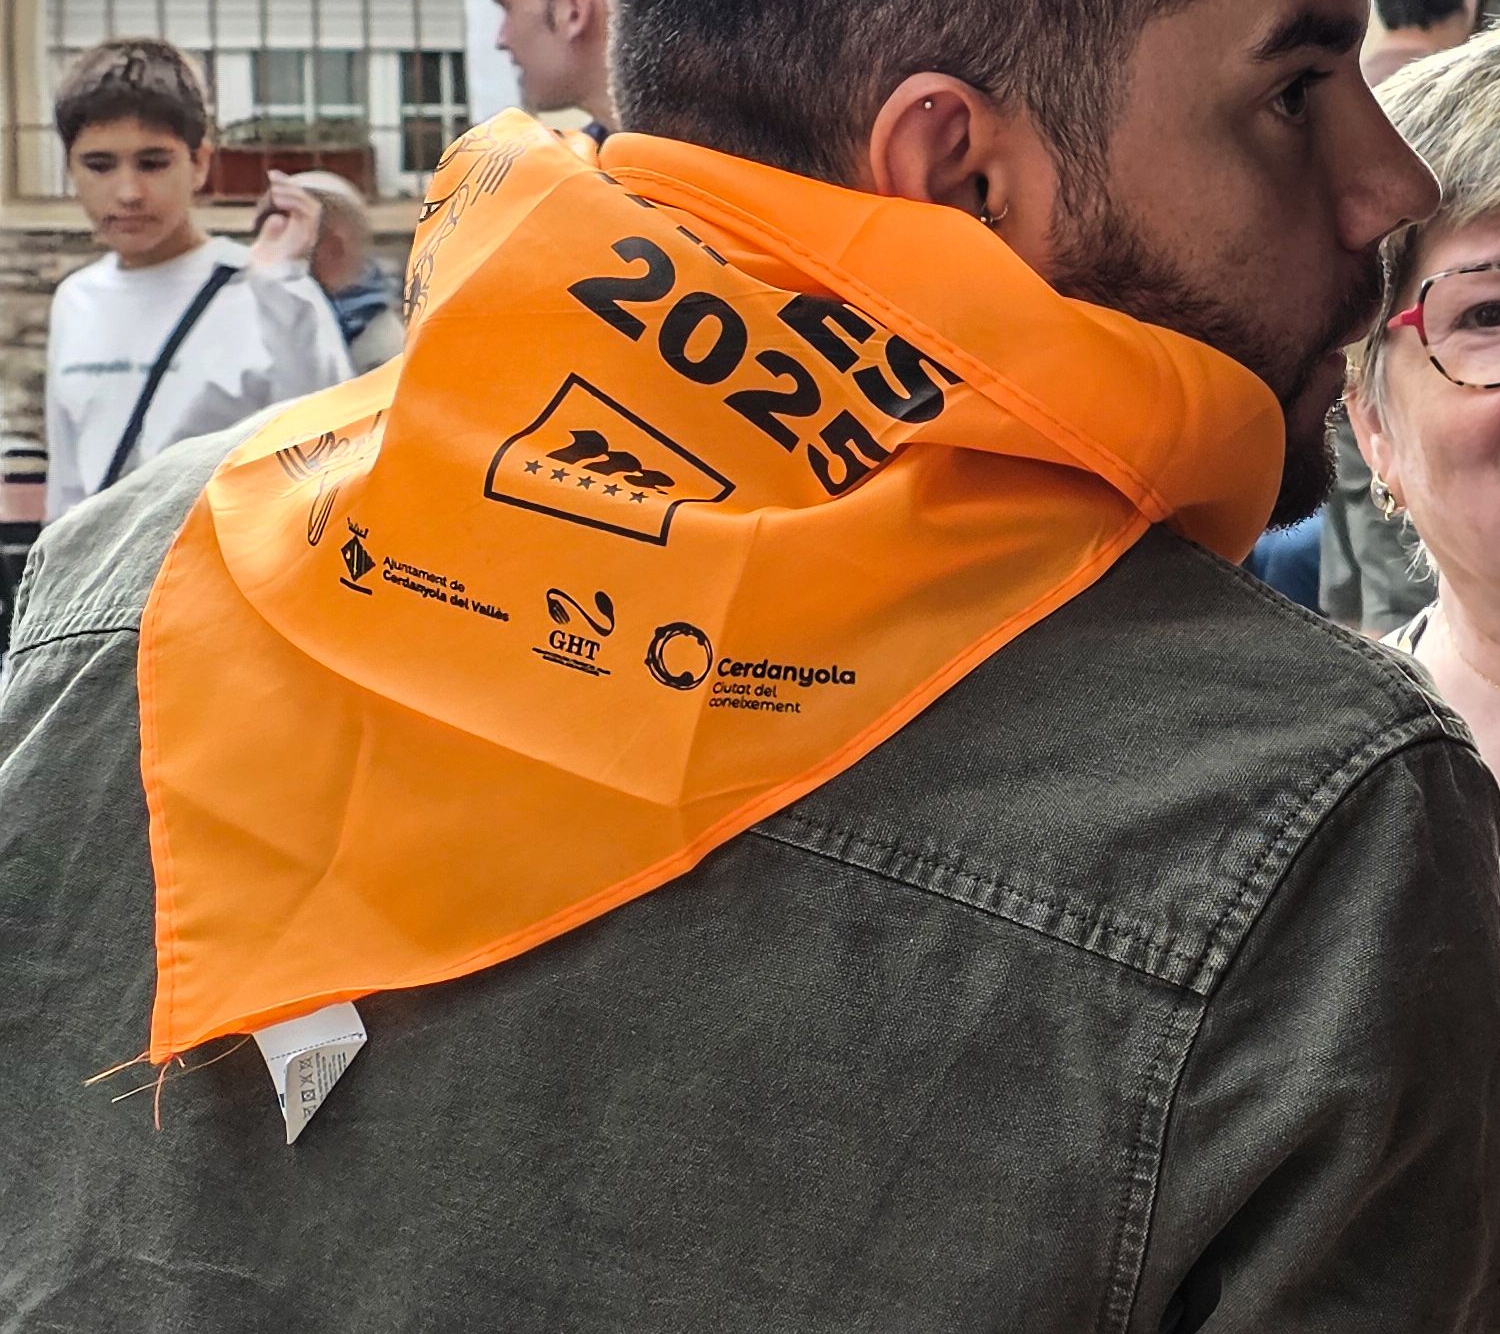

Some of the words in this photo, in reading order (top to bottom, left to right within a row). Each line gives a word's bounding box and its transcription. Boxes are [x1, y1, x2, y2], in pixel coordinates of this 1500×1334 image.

[567, 236, 892, 497] 2025
[382, 556, 448, 588] Ajuntament
[449, 579, 466, 593] de
[382, 569, 448, 602] Cerdanyola
[449, 594, 469, 610] del
[549, 629, 601, 661] GHT
[716, 657, 856, 687] Cerdanyola
[708, 696, 801, 714] coneixement
[712, 681, 751, 696] Ciutat
[754, 682, 777, 698] del
